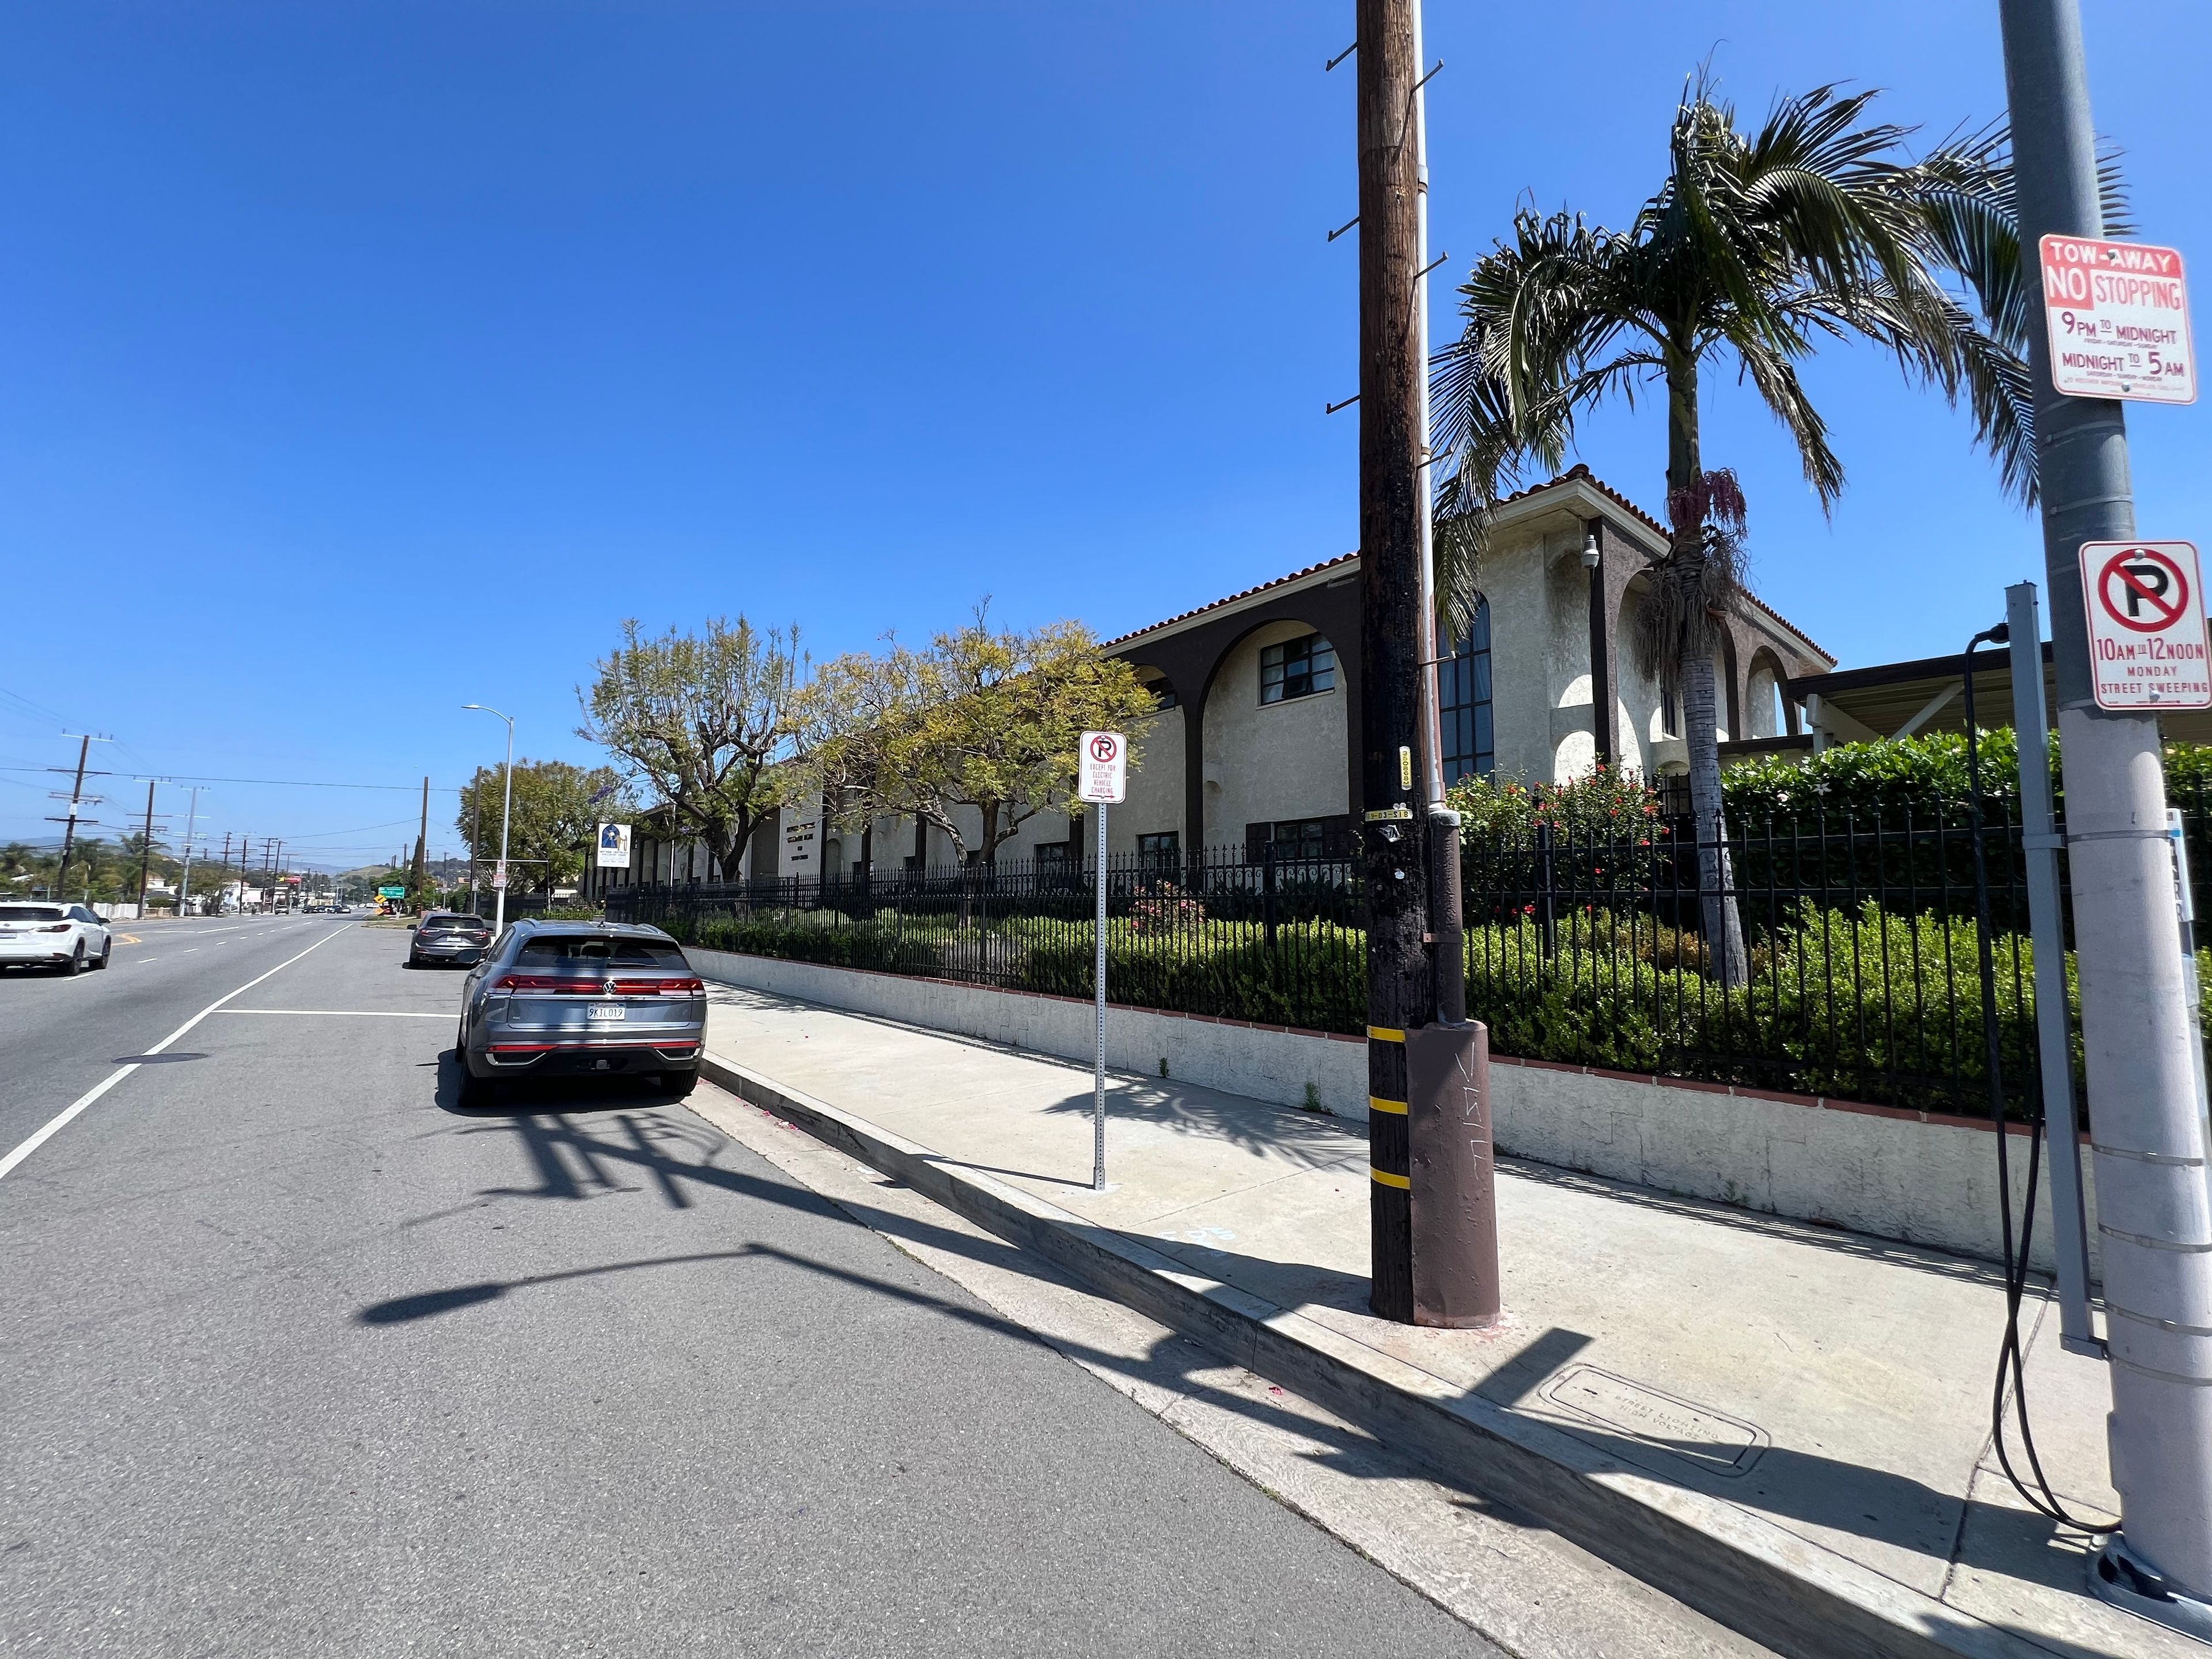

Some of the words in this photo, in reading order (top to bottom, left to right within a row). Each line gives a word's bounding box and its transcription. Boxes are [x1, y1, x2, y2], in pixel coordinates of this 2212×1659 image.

[2049, 241, 2173, 272] TOW-AWAY
[2047, 266, 2086, 301] NO
[2095, 275, 2181, 310] STOPPING
[2100, 319, 2111, 330] TO
[2116, 325, 2177, 344] MIDNIGHT
[2062, 353, 2124, 372] MIDNIGHT
[2127, 353, 2140, 363] TO
[2127, 666, 2177, 677] MONDAY
[2101, 683, 2142, 694] STREET
[2149, 682, 2208, 694] SWEEPING
[1093, 779, 1111, 787] VEHICLE
[1091, 786, 1113, 794] CHARGING
[589, 1008, 623, 1018] 9KIL019
